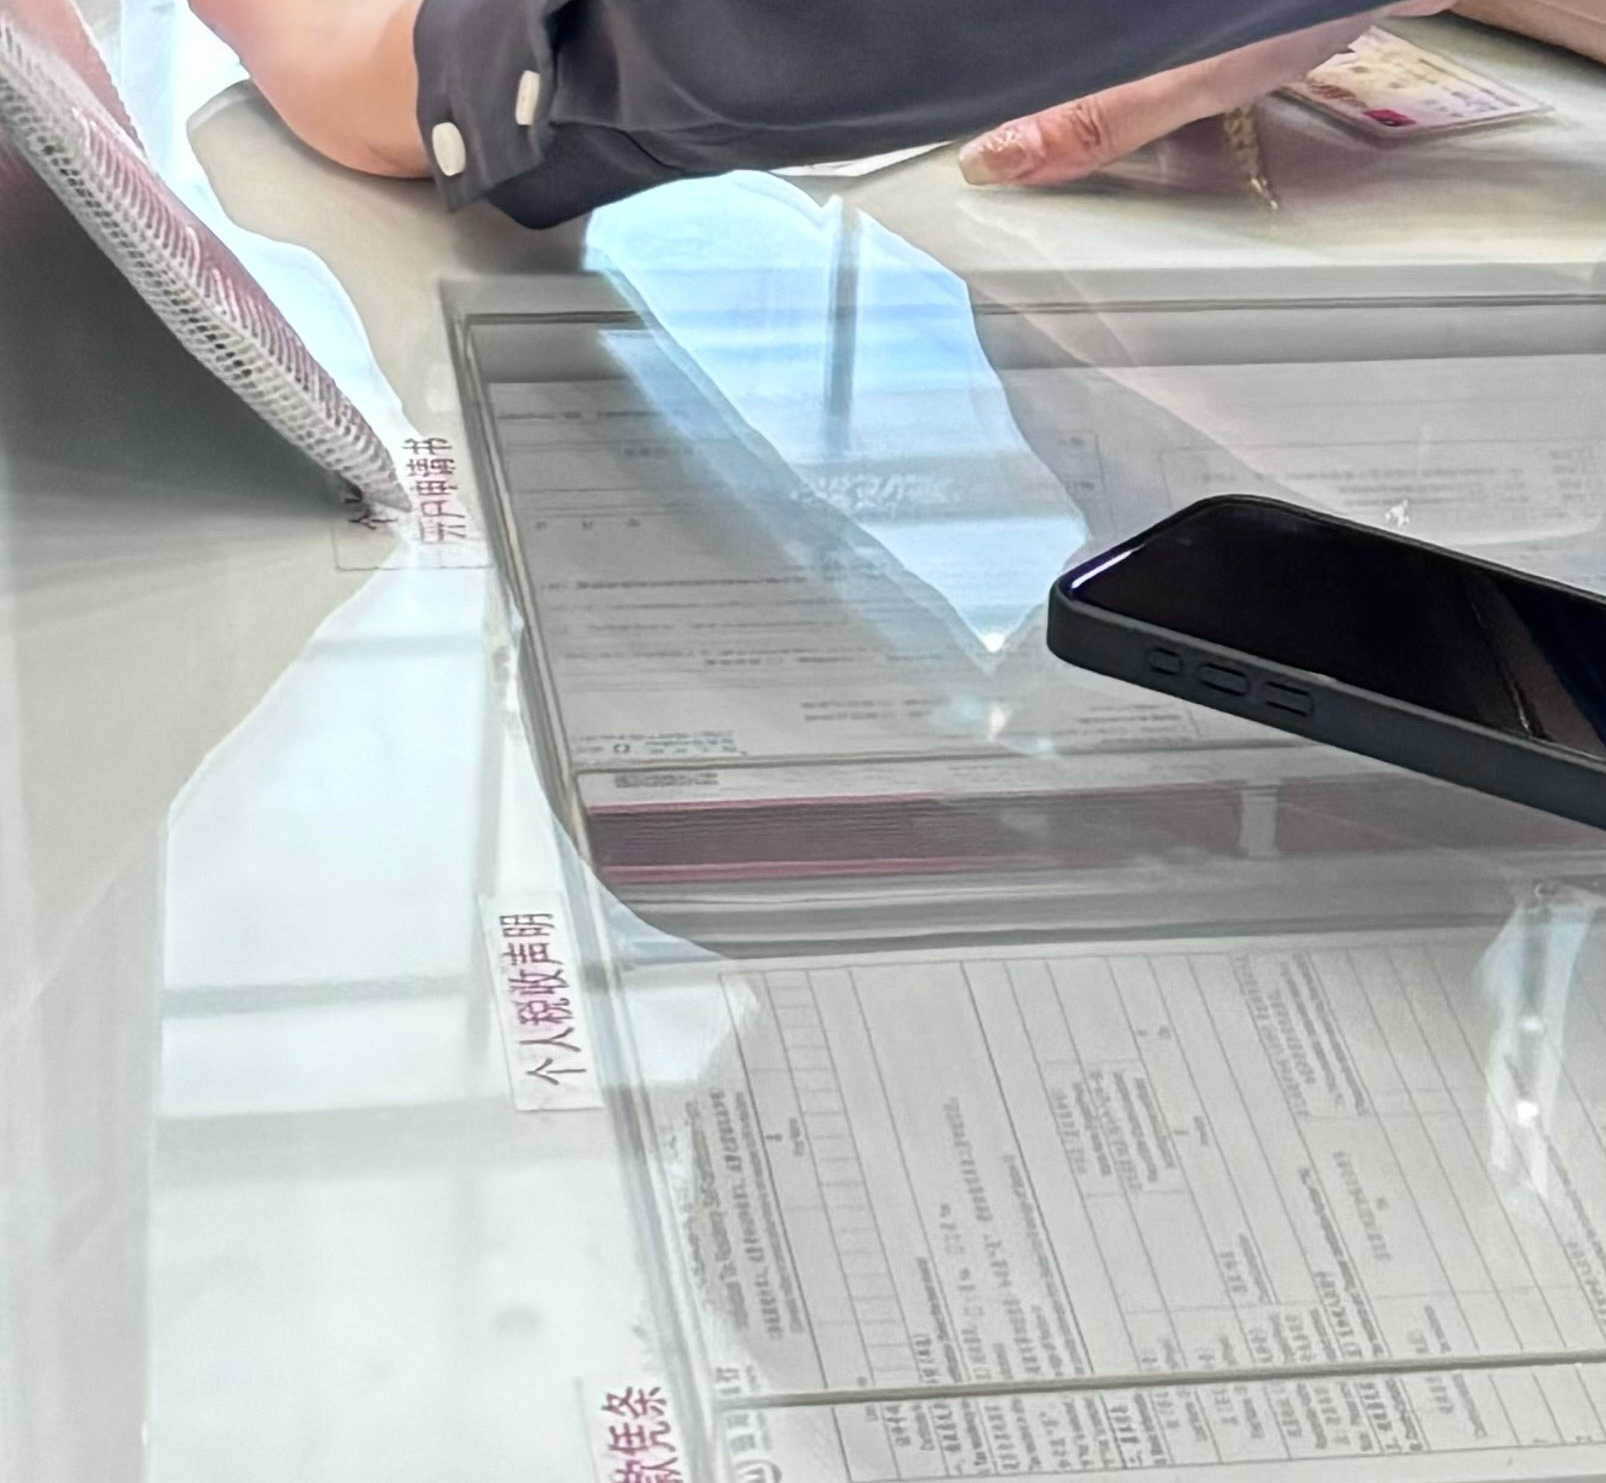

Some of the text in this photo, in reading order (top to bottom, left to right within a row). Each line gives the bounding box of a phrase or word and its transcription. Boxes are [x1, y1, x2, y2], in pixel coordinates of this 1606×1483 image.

[499, 913, 587, 1087] 个人税收声明
